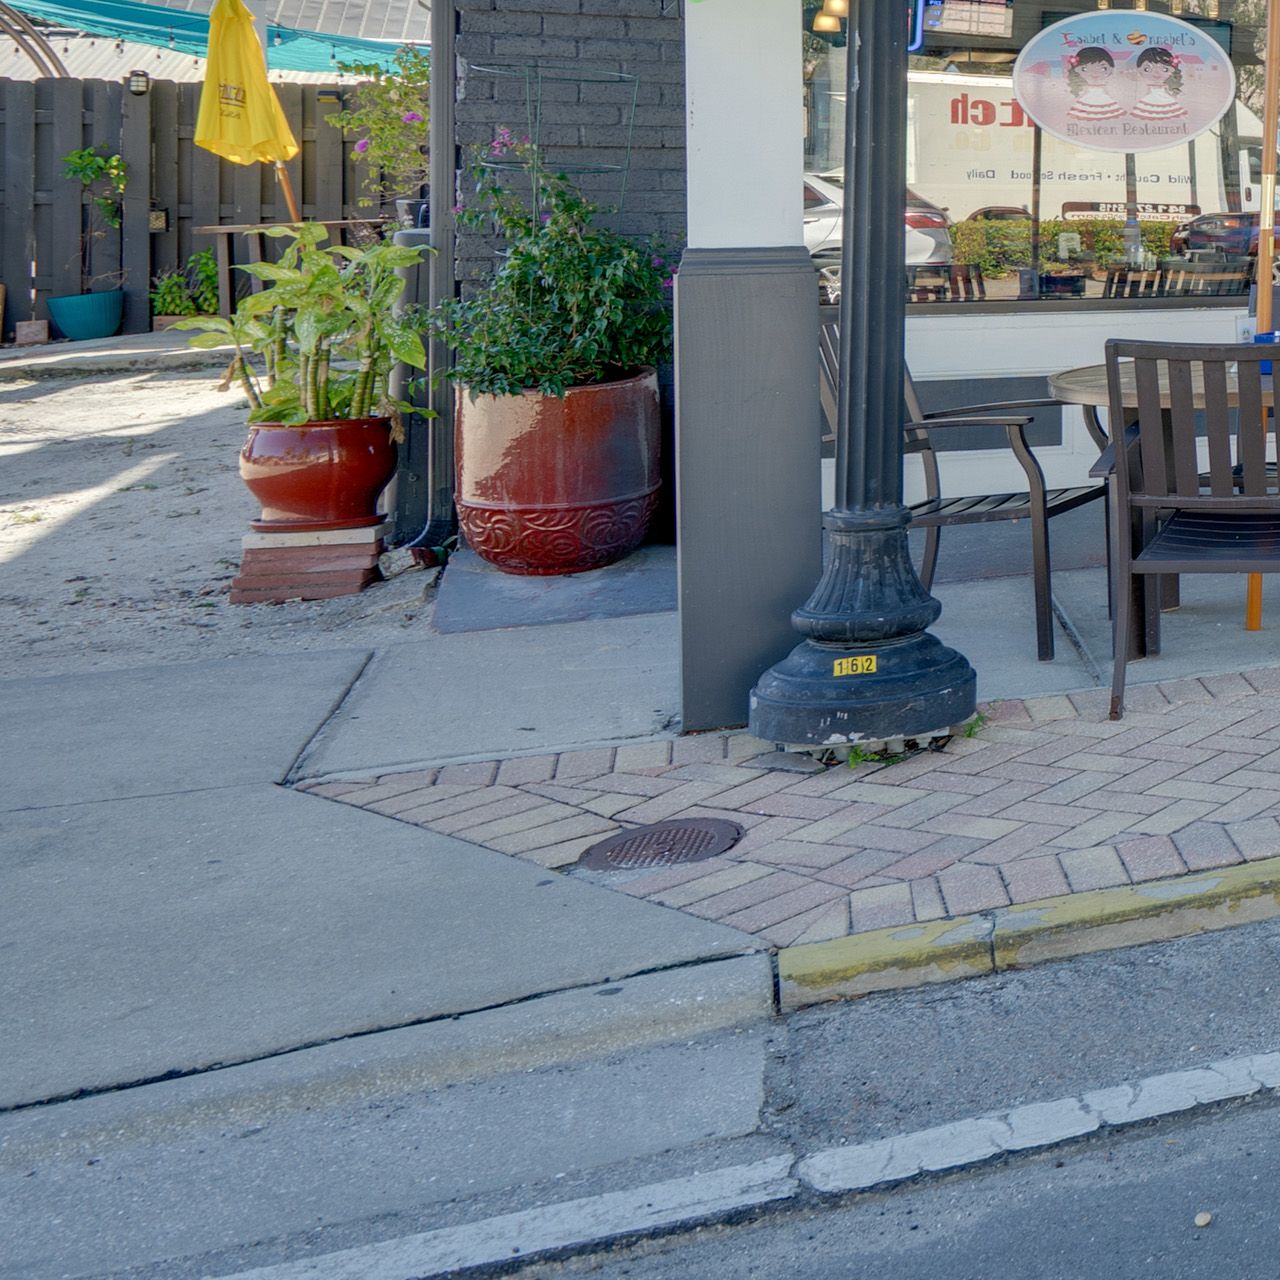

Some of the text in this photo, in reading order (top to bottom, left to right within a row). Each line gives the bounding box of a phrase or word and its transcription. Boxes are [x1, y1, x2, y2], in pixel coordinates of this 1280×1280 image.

[1066, 122, 1189, 136] Mexican Restaurant
[837, 657, 873, 674] 162
